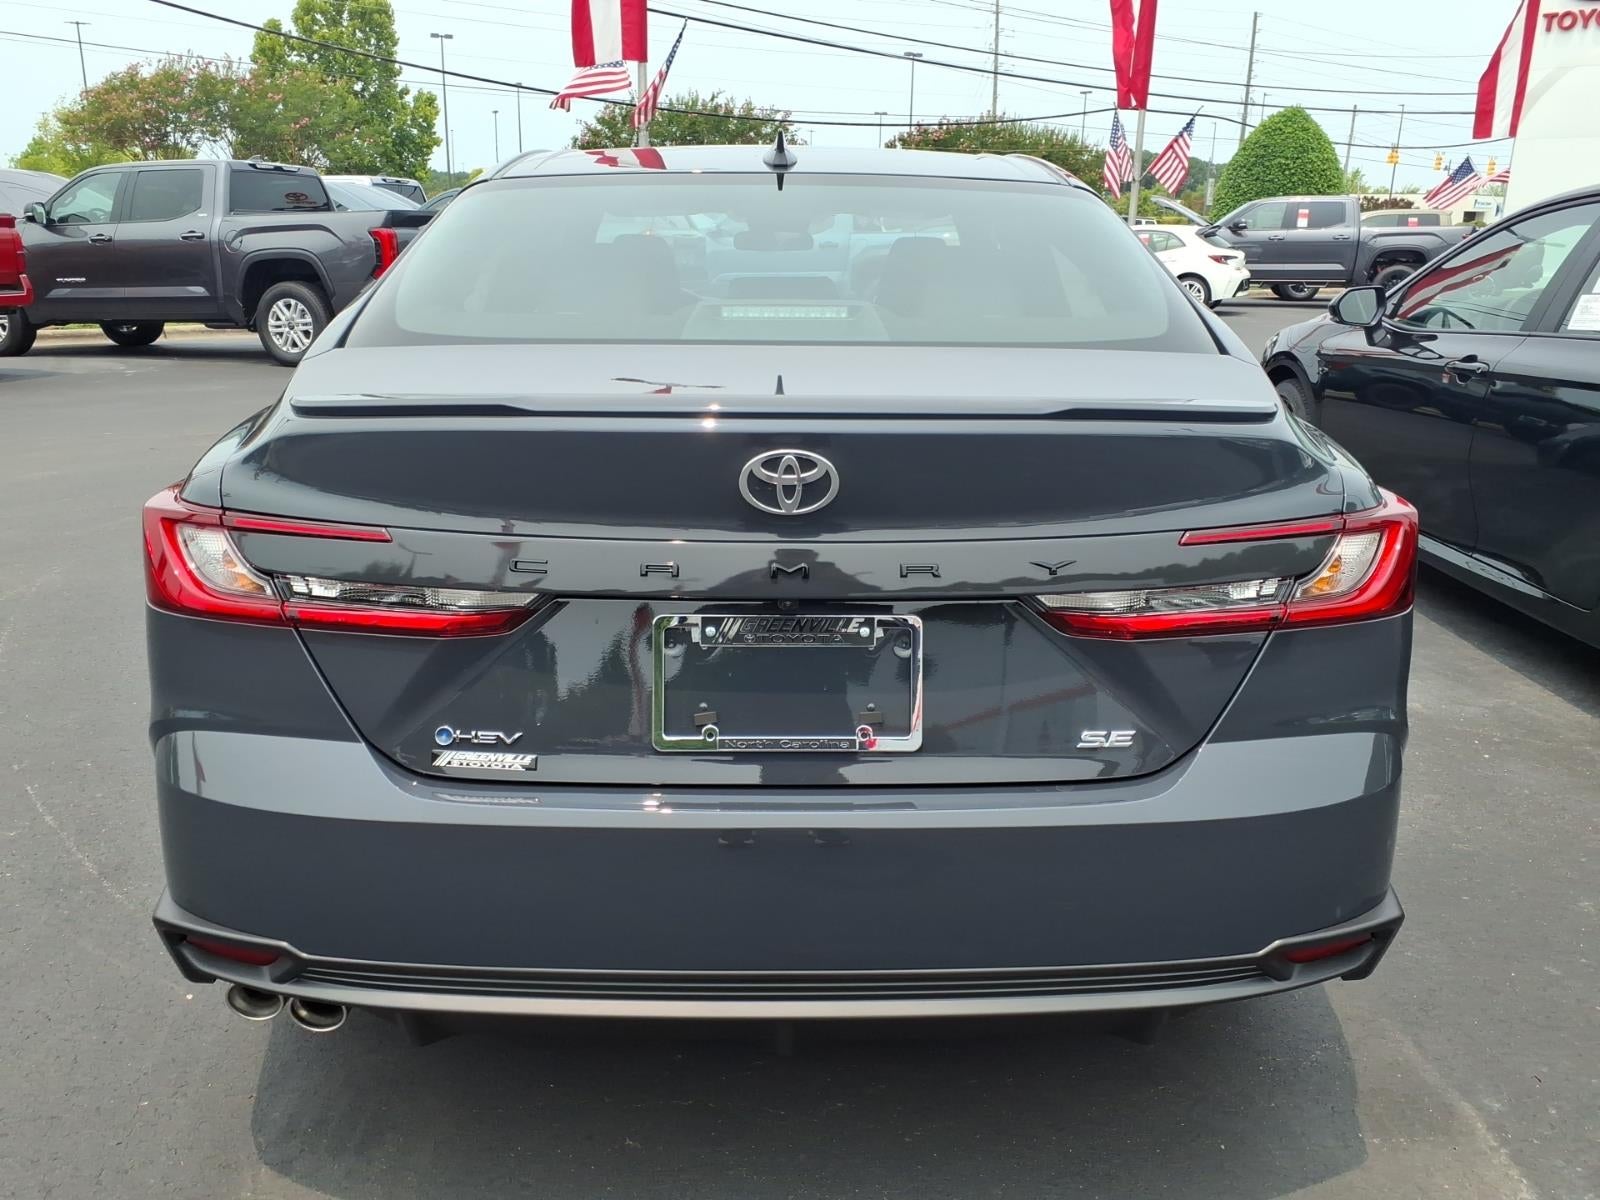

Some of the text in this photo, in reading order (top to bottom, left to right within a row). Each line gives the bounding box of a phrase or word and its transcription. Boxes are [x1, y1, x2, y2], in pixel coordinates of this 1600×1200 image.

[1542, 8, 1600, 32] TOY
[509, 558, 1076, 579] CAMRY
[739, 618, 865, 633] GREENVILLE
[757, 633, 846, 643] TOYOTA
[455, 730, 523, 744] HEV
[724, 739, 850, 748] North Carolina
[1076, 730, 1136, 748] SE
